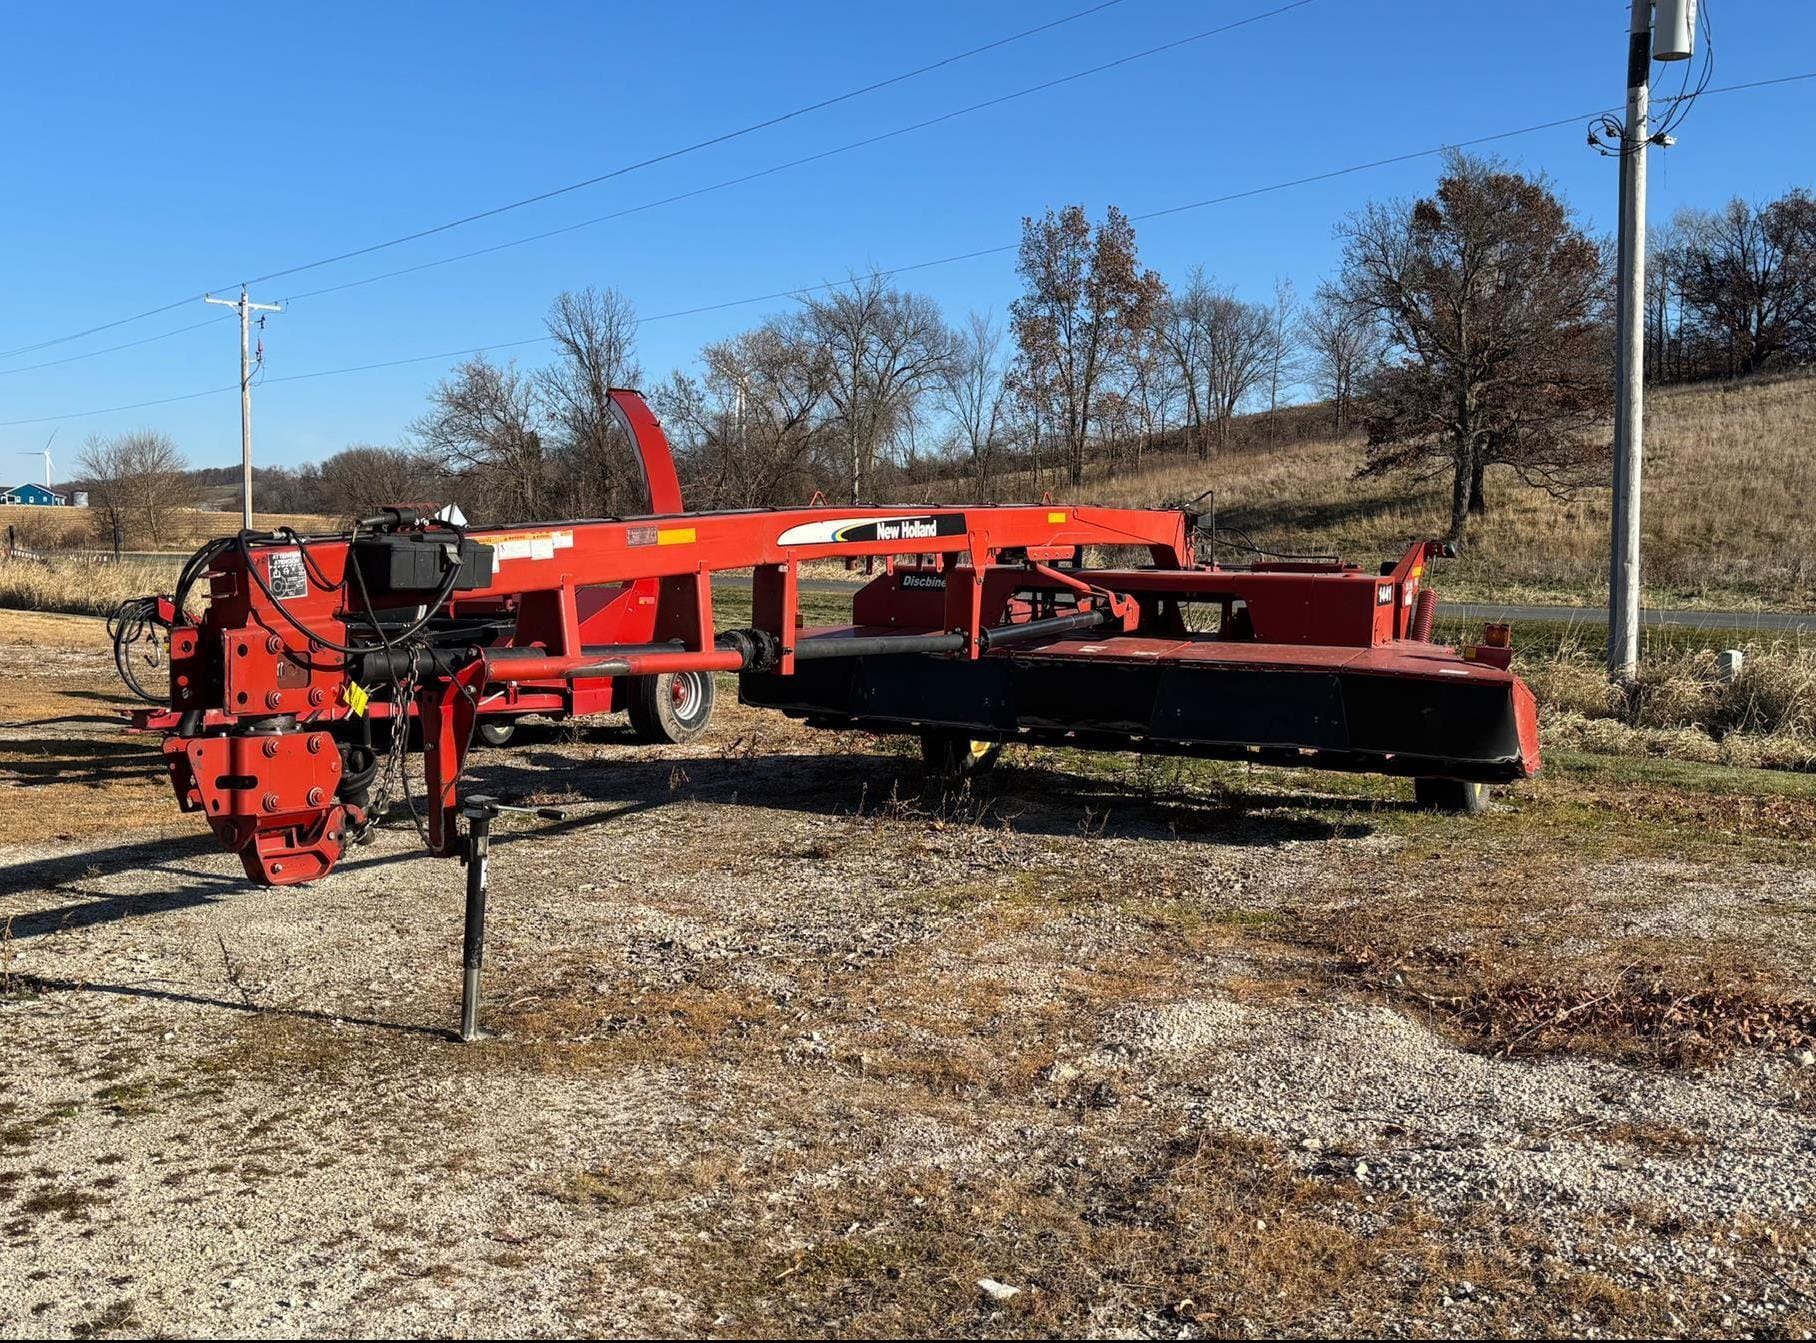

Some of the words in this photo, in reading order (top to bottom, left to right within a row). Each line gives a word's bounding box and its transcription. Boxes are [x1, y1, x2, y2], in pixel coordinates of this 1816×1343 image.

[876, 521, 899, 540] New
[901, 520, 937, 538] Holland
[903, 575, 946, 588] Discbine
[1378, 585, 1392, 603] 1441
